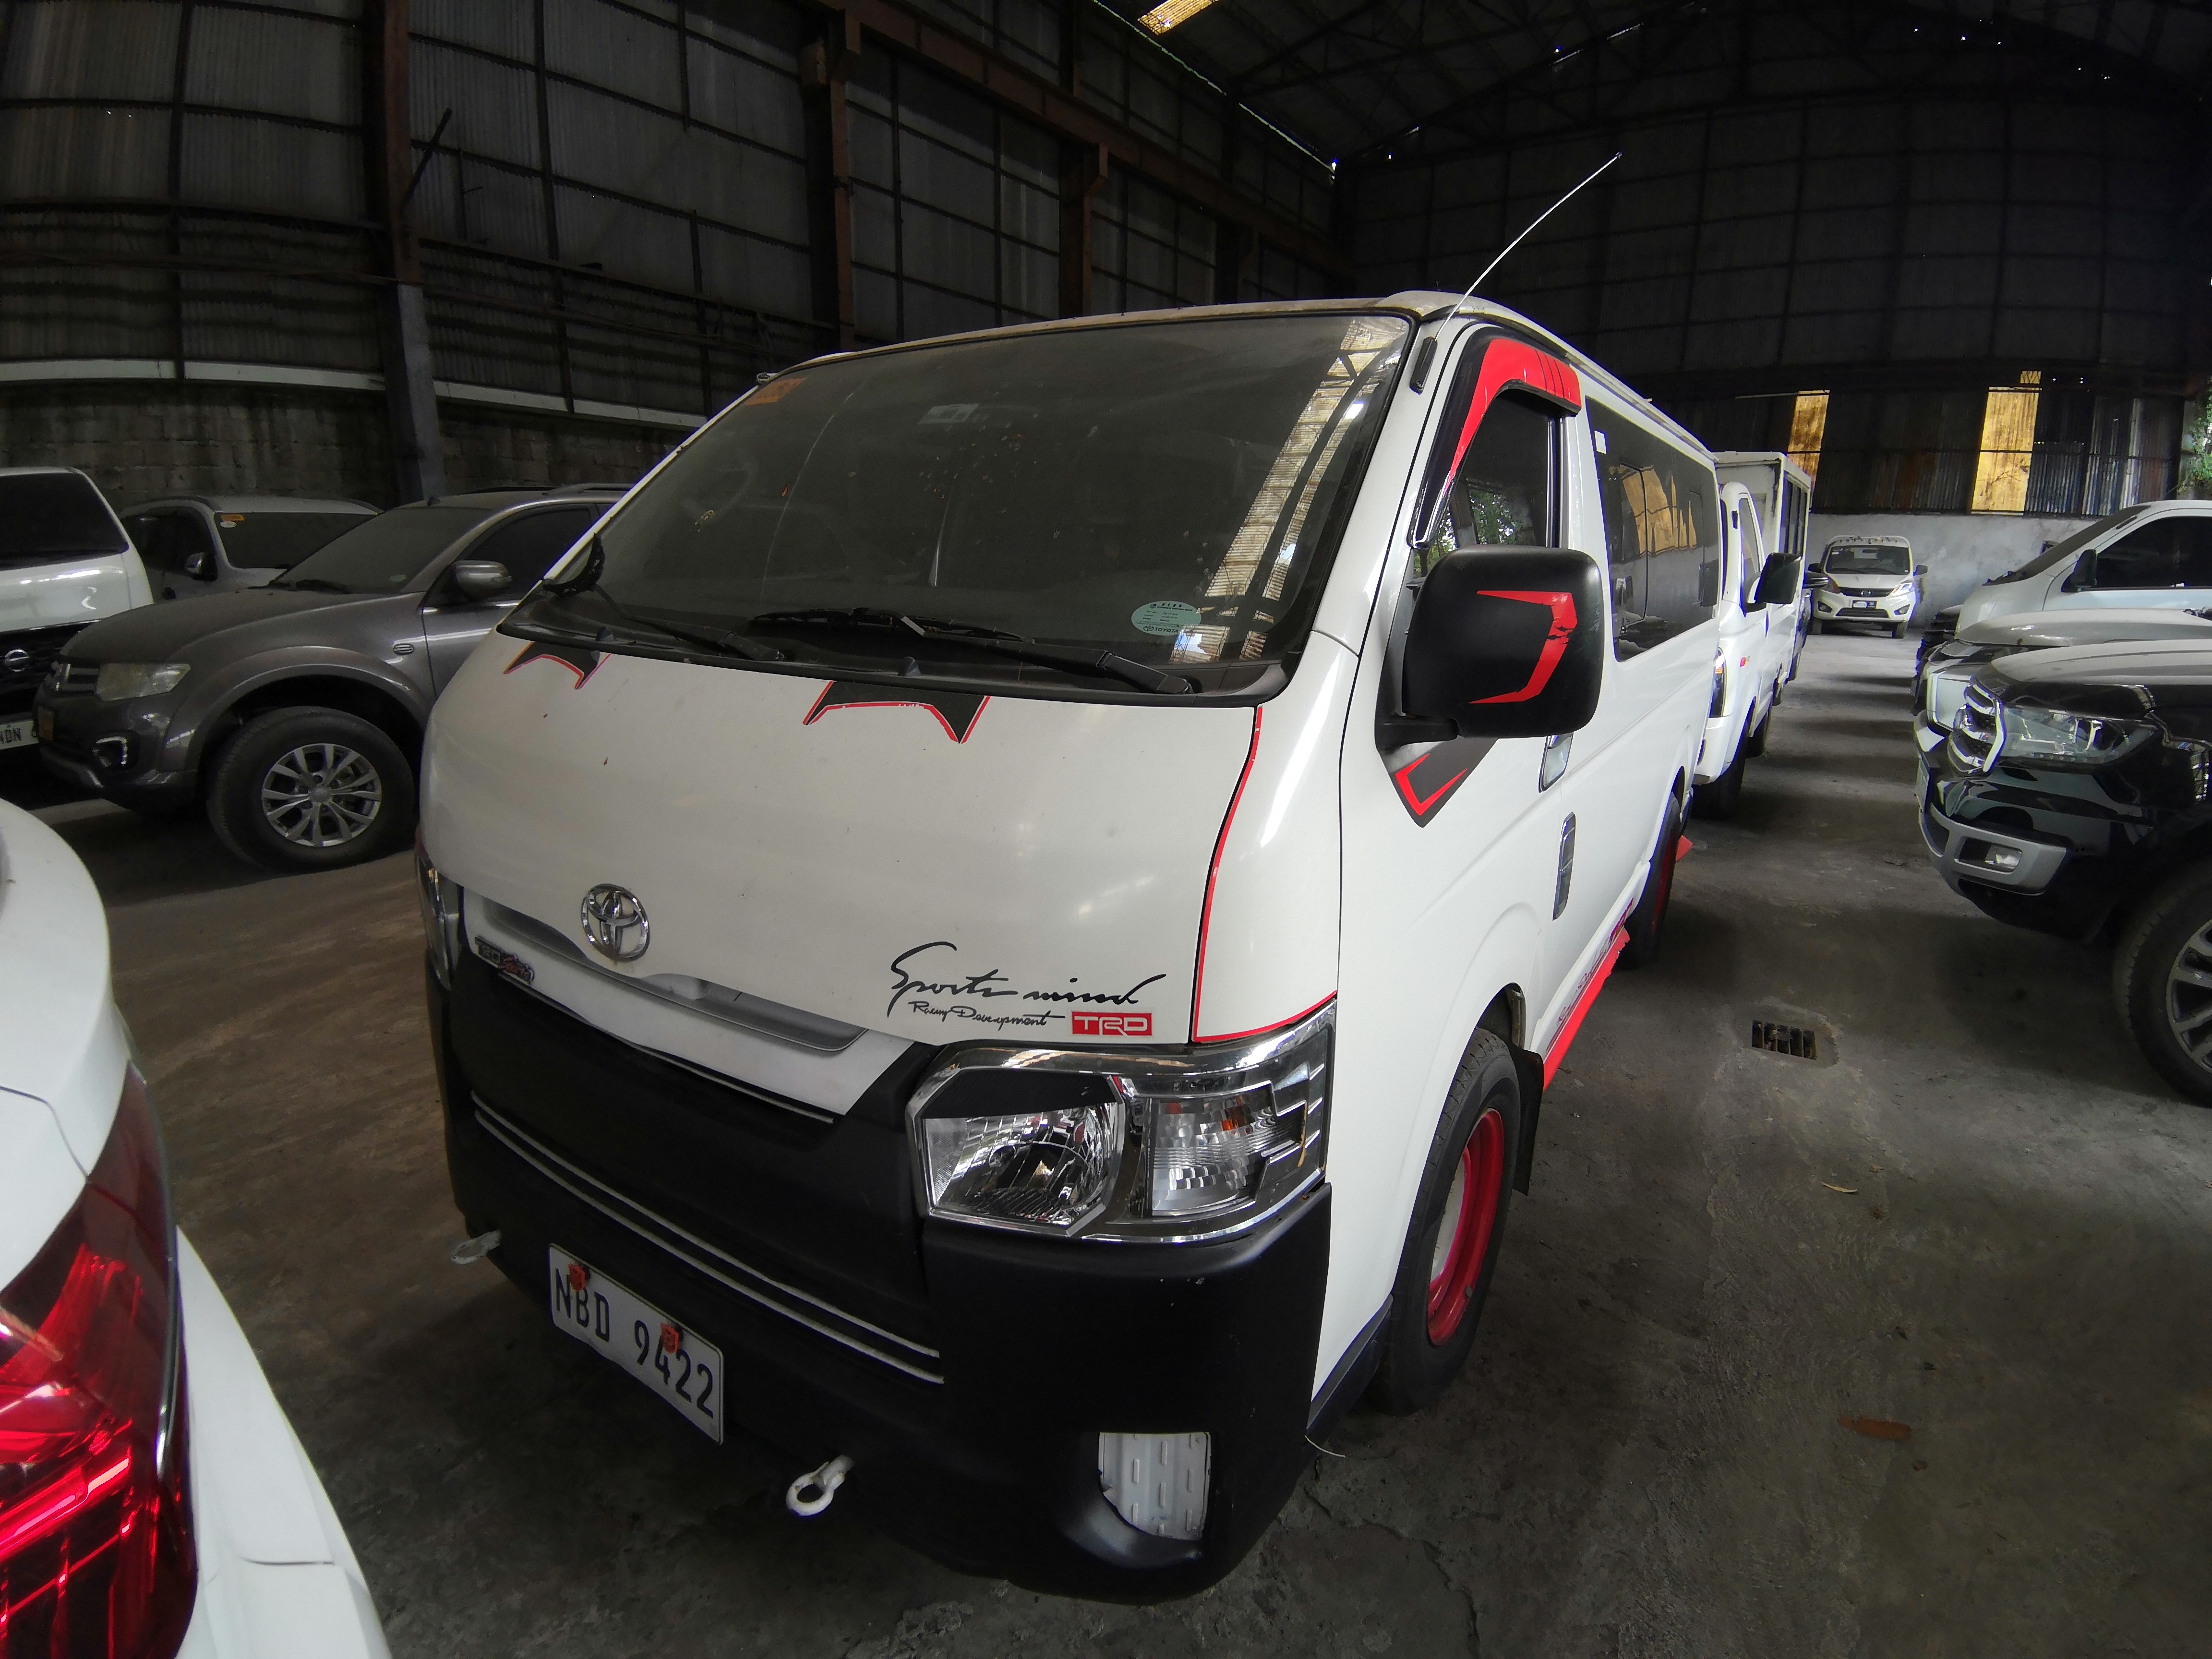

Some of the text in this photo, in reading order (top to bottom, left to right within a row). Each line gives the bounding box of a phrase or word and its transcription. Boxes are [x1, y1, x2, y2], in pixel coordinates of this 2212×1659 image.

[887, 941, 1167, 1018] Sports mind
[1074, 1016, 1148, 1035] TRD
[555, 1268, 714, 1419] NBD 9422
